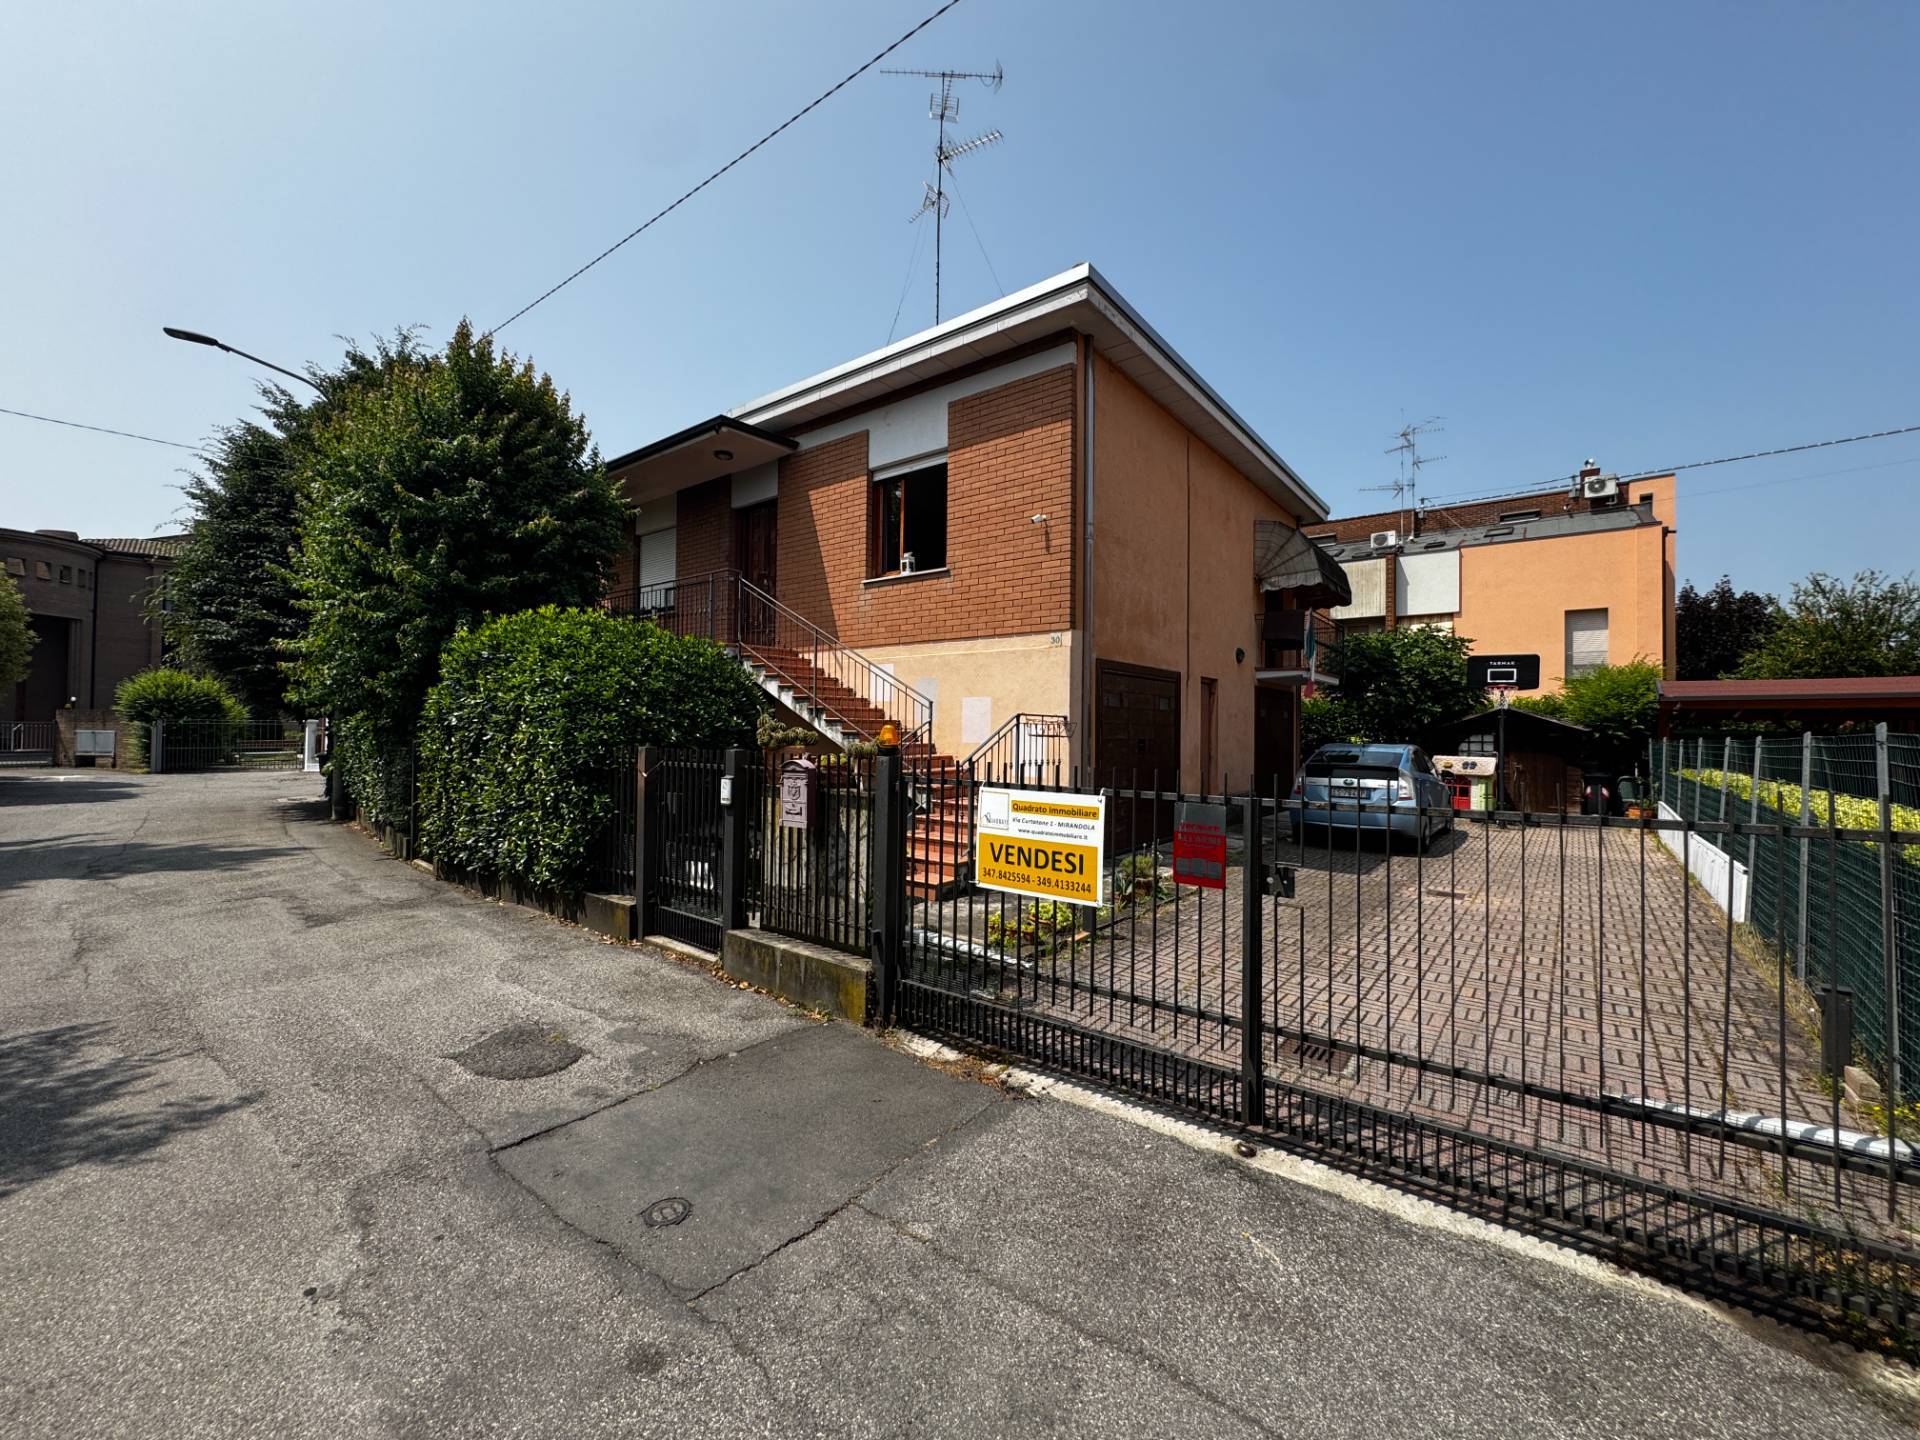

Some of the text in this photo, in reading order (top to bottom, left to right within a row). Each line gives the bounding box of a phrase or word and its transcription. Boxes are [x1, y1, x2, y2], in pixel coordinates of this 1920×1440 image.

[1012, 803, 1047, 813] Quadrato
[1022, 818, 1049, 826] Curtatone
[1058, 822, 1095, 831] MIRANDOLA
[990, 842, 1084, 875] VENDESI
[983, 867, 1031, 884] 347.8425594
[1036, 876, 1091, 893] 349.4133244
